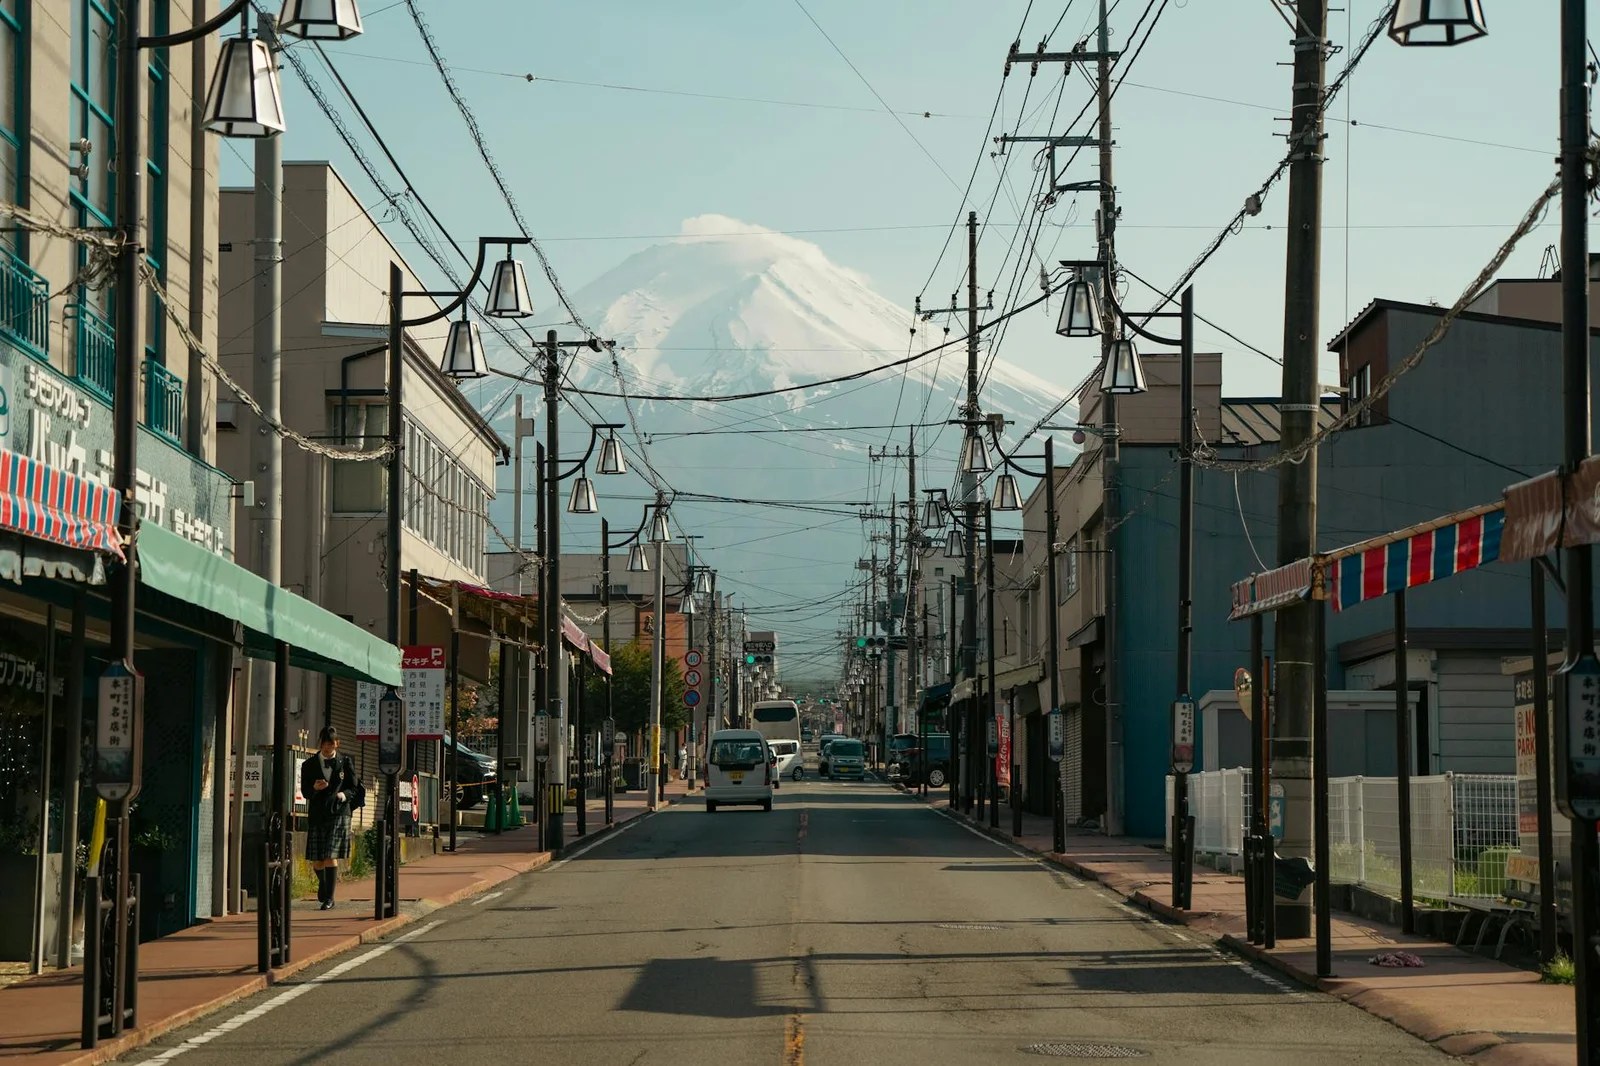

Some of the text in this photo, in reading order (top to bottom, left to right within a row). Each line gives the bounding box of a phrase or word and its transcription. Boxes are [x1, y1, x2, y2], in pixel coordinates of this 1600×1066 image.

[431, 647, 443, 660] P
[689, 655, 697, 663] 40
[403, 657, 429, 666] マキチ
[109, 678, 121, 747] 本町名店街
[1582, 676, 1597, 756] 本町名店街
